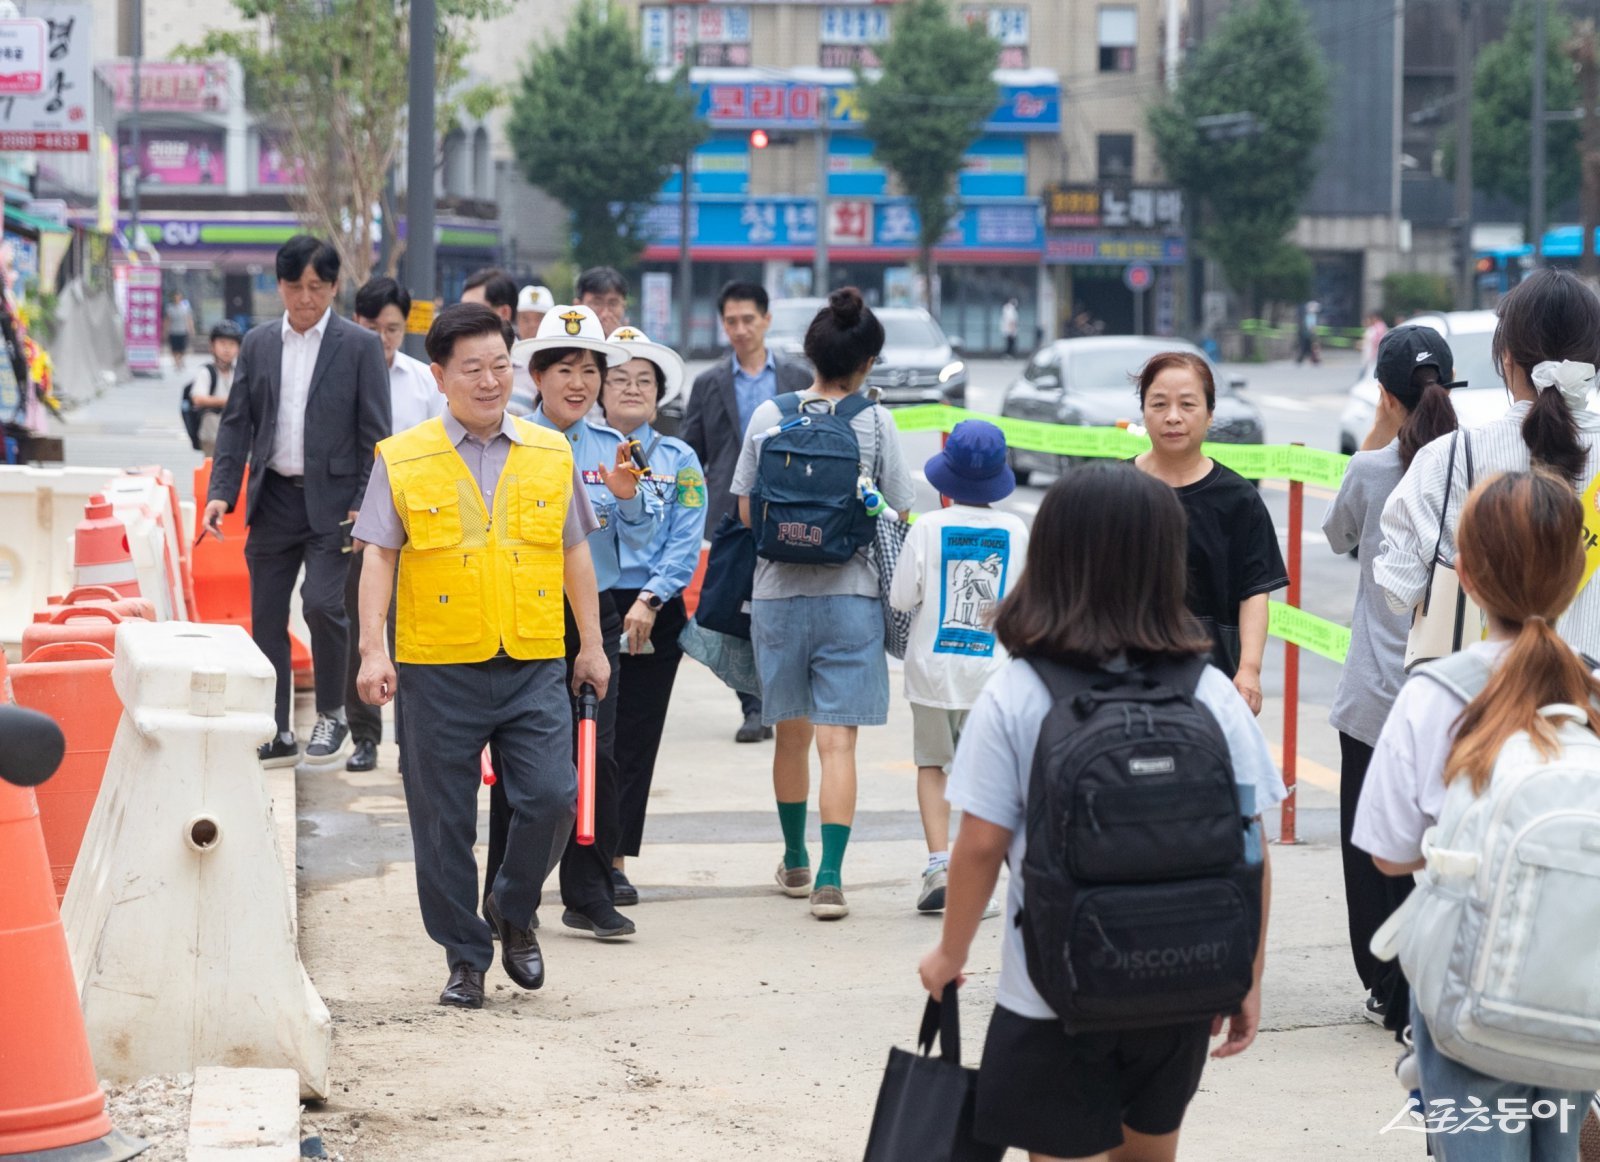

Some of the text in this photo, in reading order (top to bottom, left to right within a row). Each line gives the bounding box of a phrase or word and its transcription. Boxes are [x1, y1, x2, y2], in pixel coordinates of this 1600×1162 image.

[163, 221, 199, 245] CU
[777, 522, 822, 546] POLO
[948, 536, 1006, 550] THANKS HOUSE
